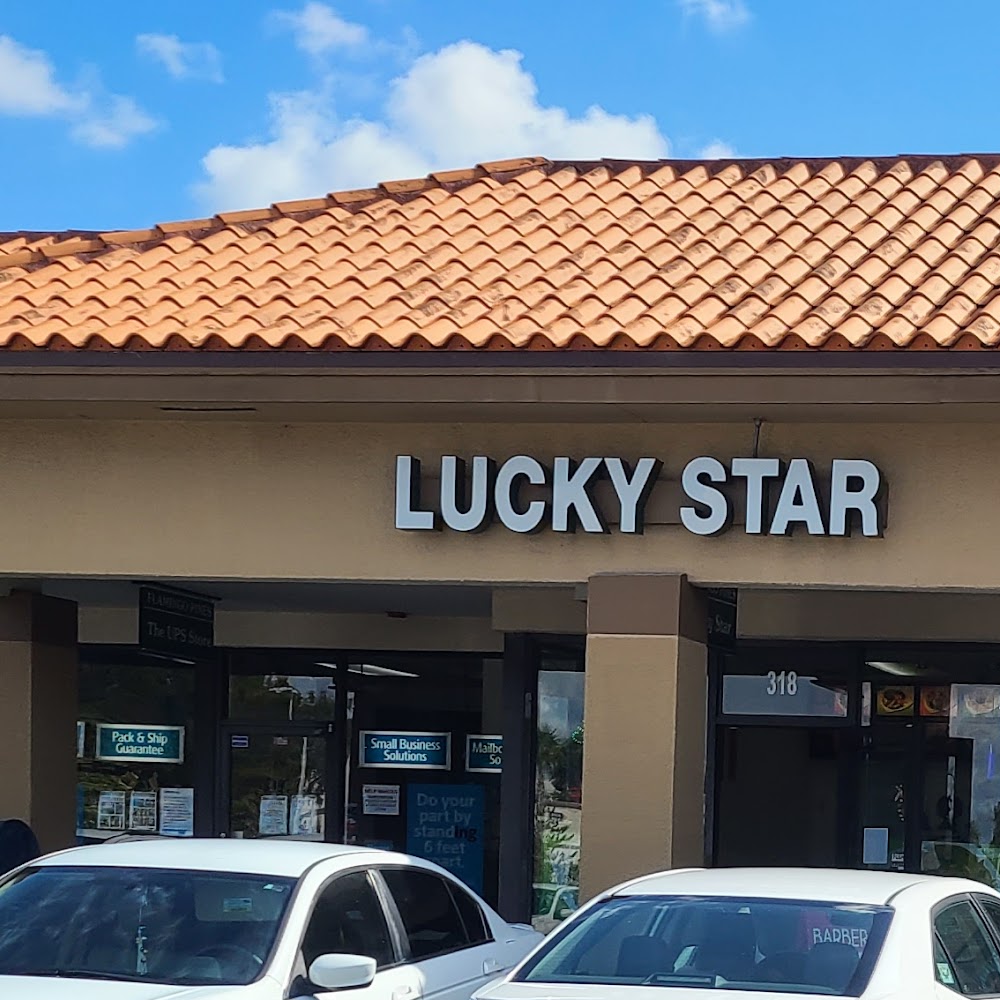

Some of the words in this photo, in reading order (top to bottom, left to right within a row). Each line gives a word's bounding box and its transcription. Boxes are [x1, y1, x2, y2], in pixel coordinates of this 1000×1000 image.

[395, 455, 657, 534] LUCKY
[679, 456, 880, 537] STAR
[766, 670, 797, 695] 318
[112, 731, 135, 743] Pack
[136, 732, 146, 743] &
[147, 732, 168, 747] Ship
[370, 737, 398, 749] Small
[400, 738, 441, 751] Business
[115, 743, 165, 755] Guarantee
[383, 750, 428, 762] Solutions
[417, 793, 438, 807] Do
[441, 796, 475, 810] your
[420, 810, 449, 826] part
[454, 810, 472, 826] by
[413, 825, 478, 842] standing
[423, 840, 433, 853] 6
[437, 840, 466, 854] feet
